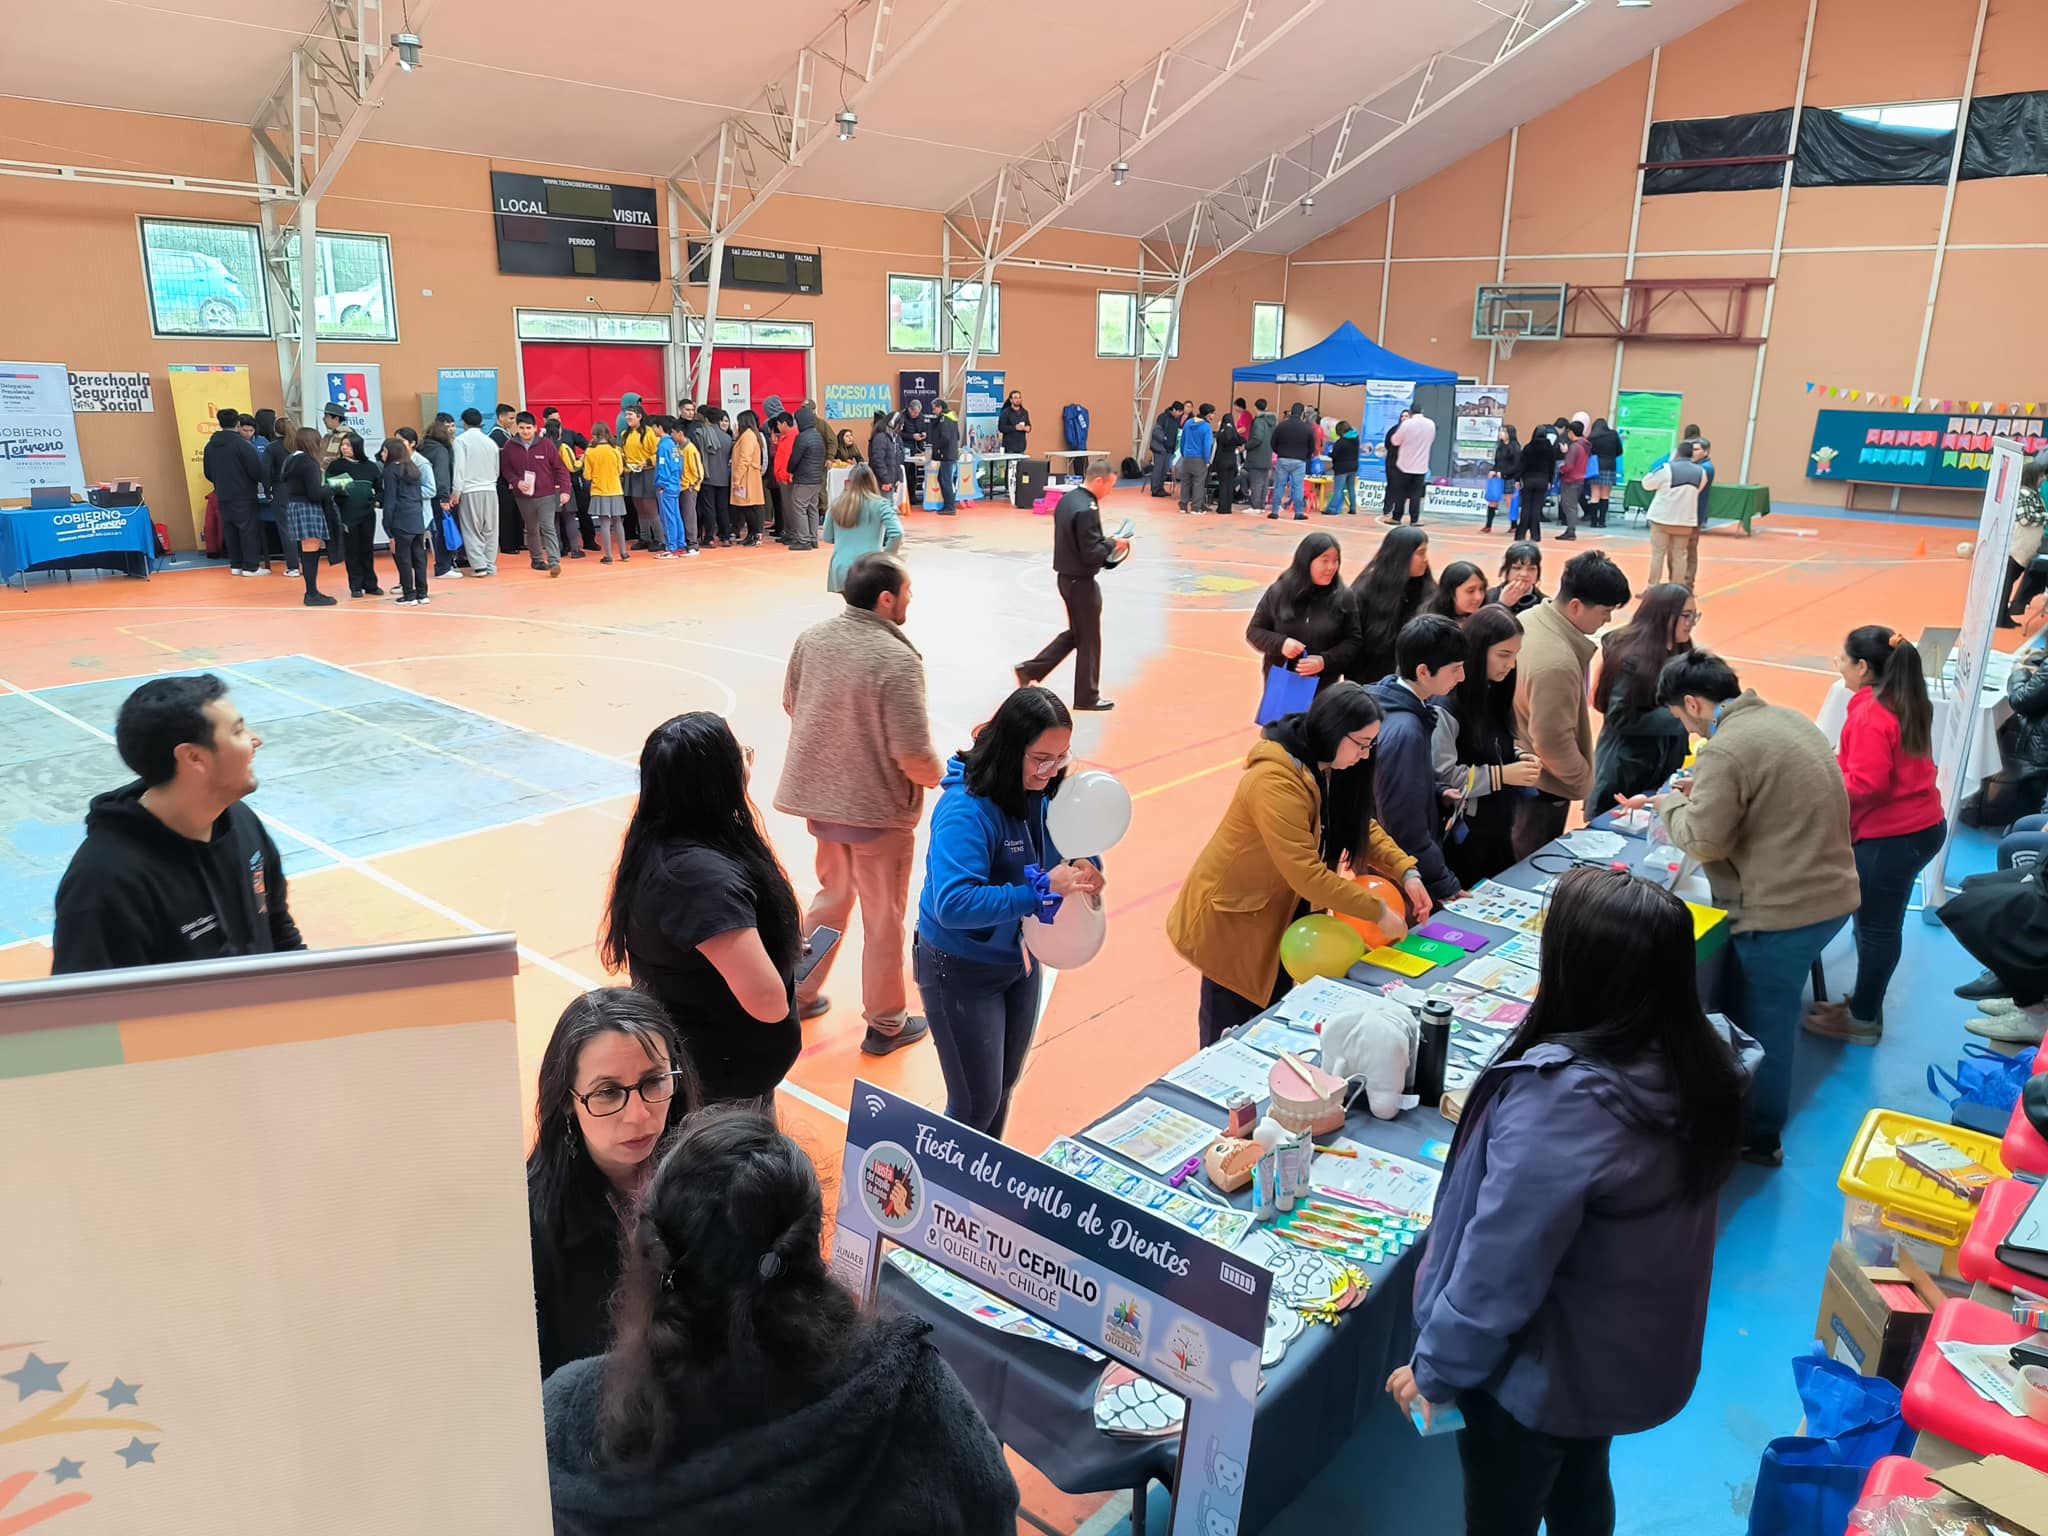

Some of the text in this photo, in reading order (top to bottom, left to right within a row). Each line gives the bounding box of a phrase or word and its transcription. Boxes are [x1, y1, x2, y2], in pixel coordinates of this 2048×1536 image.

[500, 198, 547, 215] LOCAL
[613, 209, 652, 224] VISITA
[568, 237, 596, 246] PERIODO
[794, 254, 813, 262] FALTAS
[73, 386, 149, 401] Seguridad
[825, 384, 891, 400] ACCESO A LA
[99, 398, 143, 411] Social
[0, 428, 62, 437] OBIERNO
[0, 440, 64, 460] Terreno
[1435, 487, 1469, 498] Derecho
[53, 510, 121, 526] GOBIERNO
[915, 1123, 1191, 1277] Fiesta del cepillo de Dientes
[836, 1246, 864, 1266] JUNAEB
[933, 1204, 1098, 1302] TRAE TU CEPILLO
[943, 1237, 998, 1276] QUEILEN
[1008, 1271, 1057, 1307] CHILOÉ
[1105, 1333, 1141, 1358] QUEILEN
